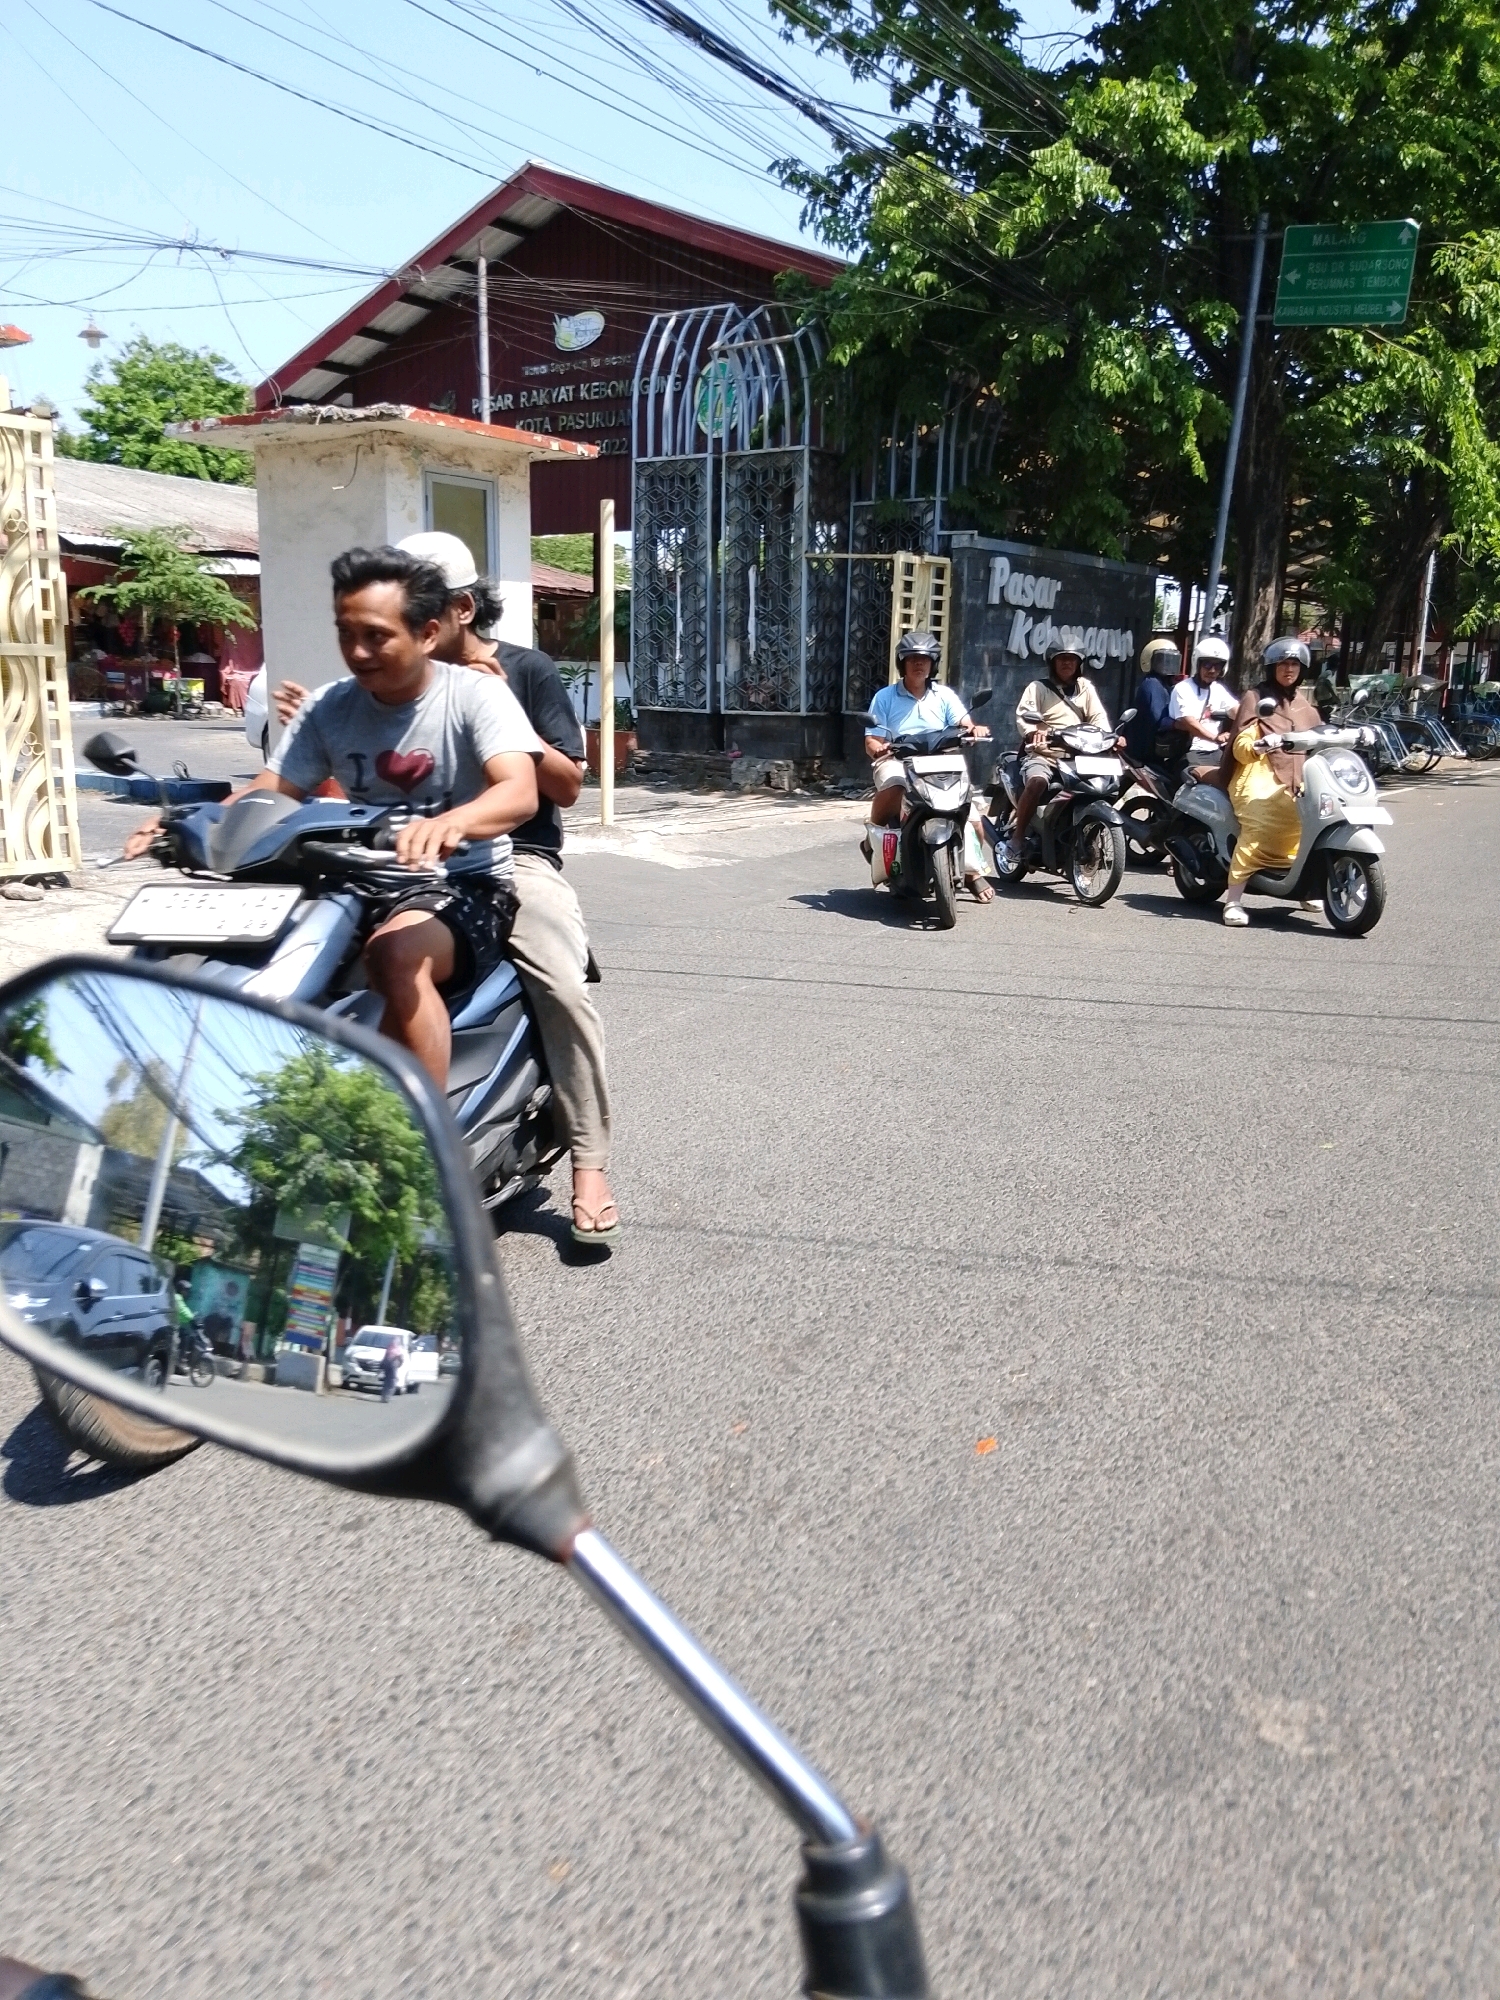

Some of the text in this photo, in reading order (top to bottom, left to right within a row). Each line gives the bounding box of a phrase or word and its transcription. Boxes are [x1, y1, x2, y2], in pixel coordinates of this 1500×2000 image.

[1312, 231, 1367, 246] MALANG
[471, 393, 514, 415] PSAR
[520, 385, 576, 409] RAKYAT
[516, 417, 553, 433] KOTA
[987, 556, 1062, 610] Pasar
